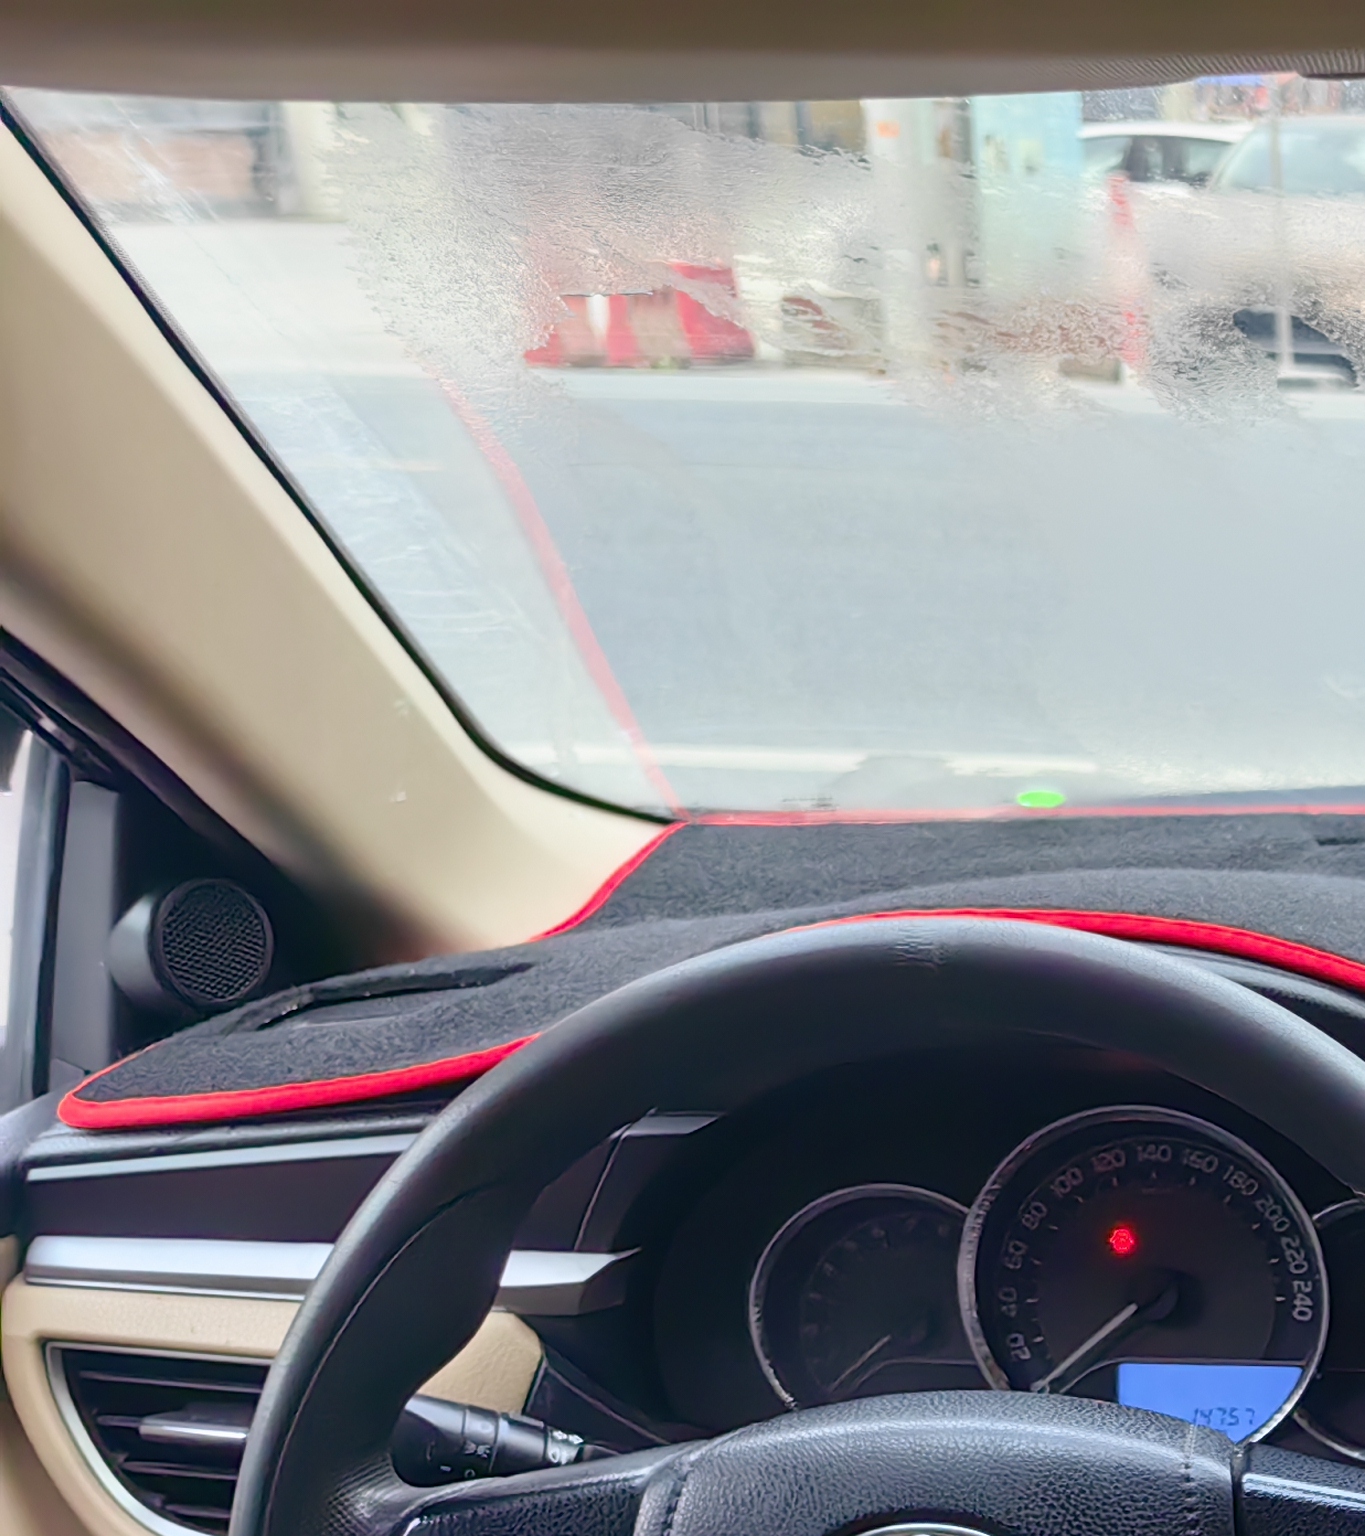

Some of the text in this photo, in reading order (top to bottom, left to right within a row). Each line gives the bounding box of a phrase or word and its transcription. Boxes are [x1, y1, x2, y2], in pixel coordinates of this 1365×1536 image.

[1050, 1167, 1084, 1198] 100
[1223, 1165, 1259, 1196] 180
[1254, 1194, 1290, 1232] 200
[1281, 1235, 1309, 1274] 220
[1292, 1280, 1313, 1321] 240
[1192, 1406, 1256, 1427] 14757
